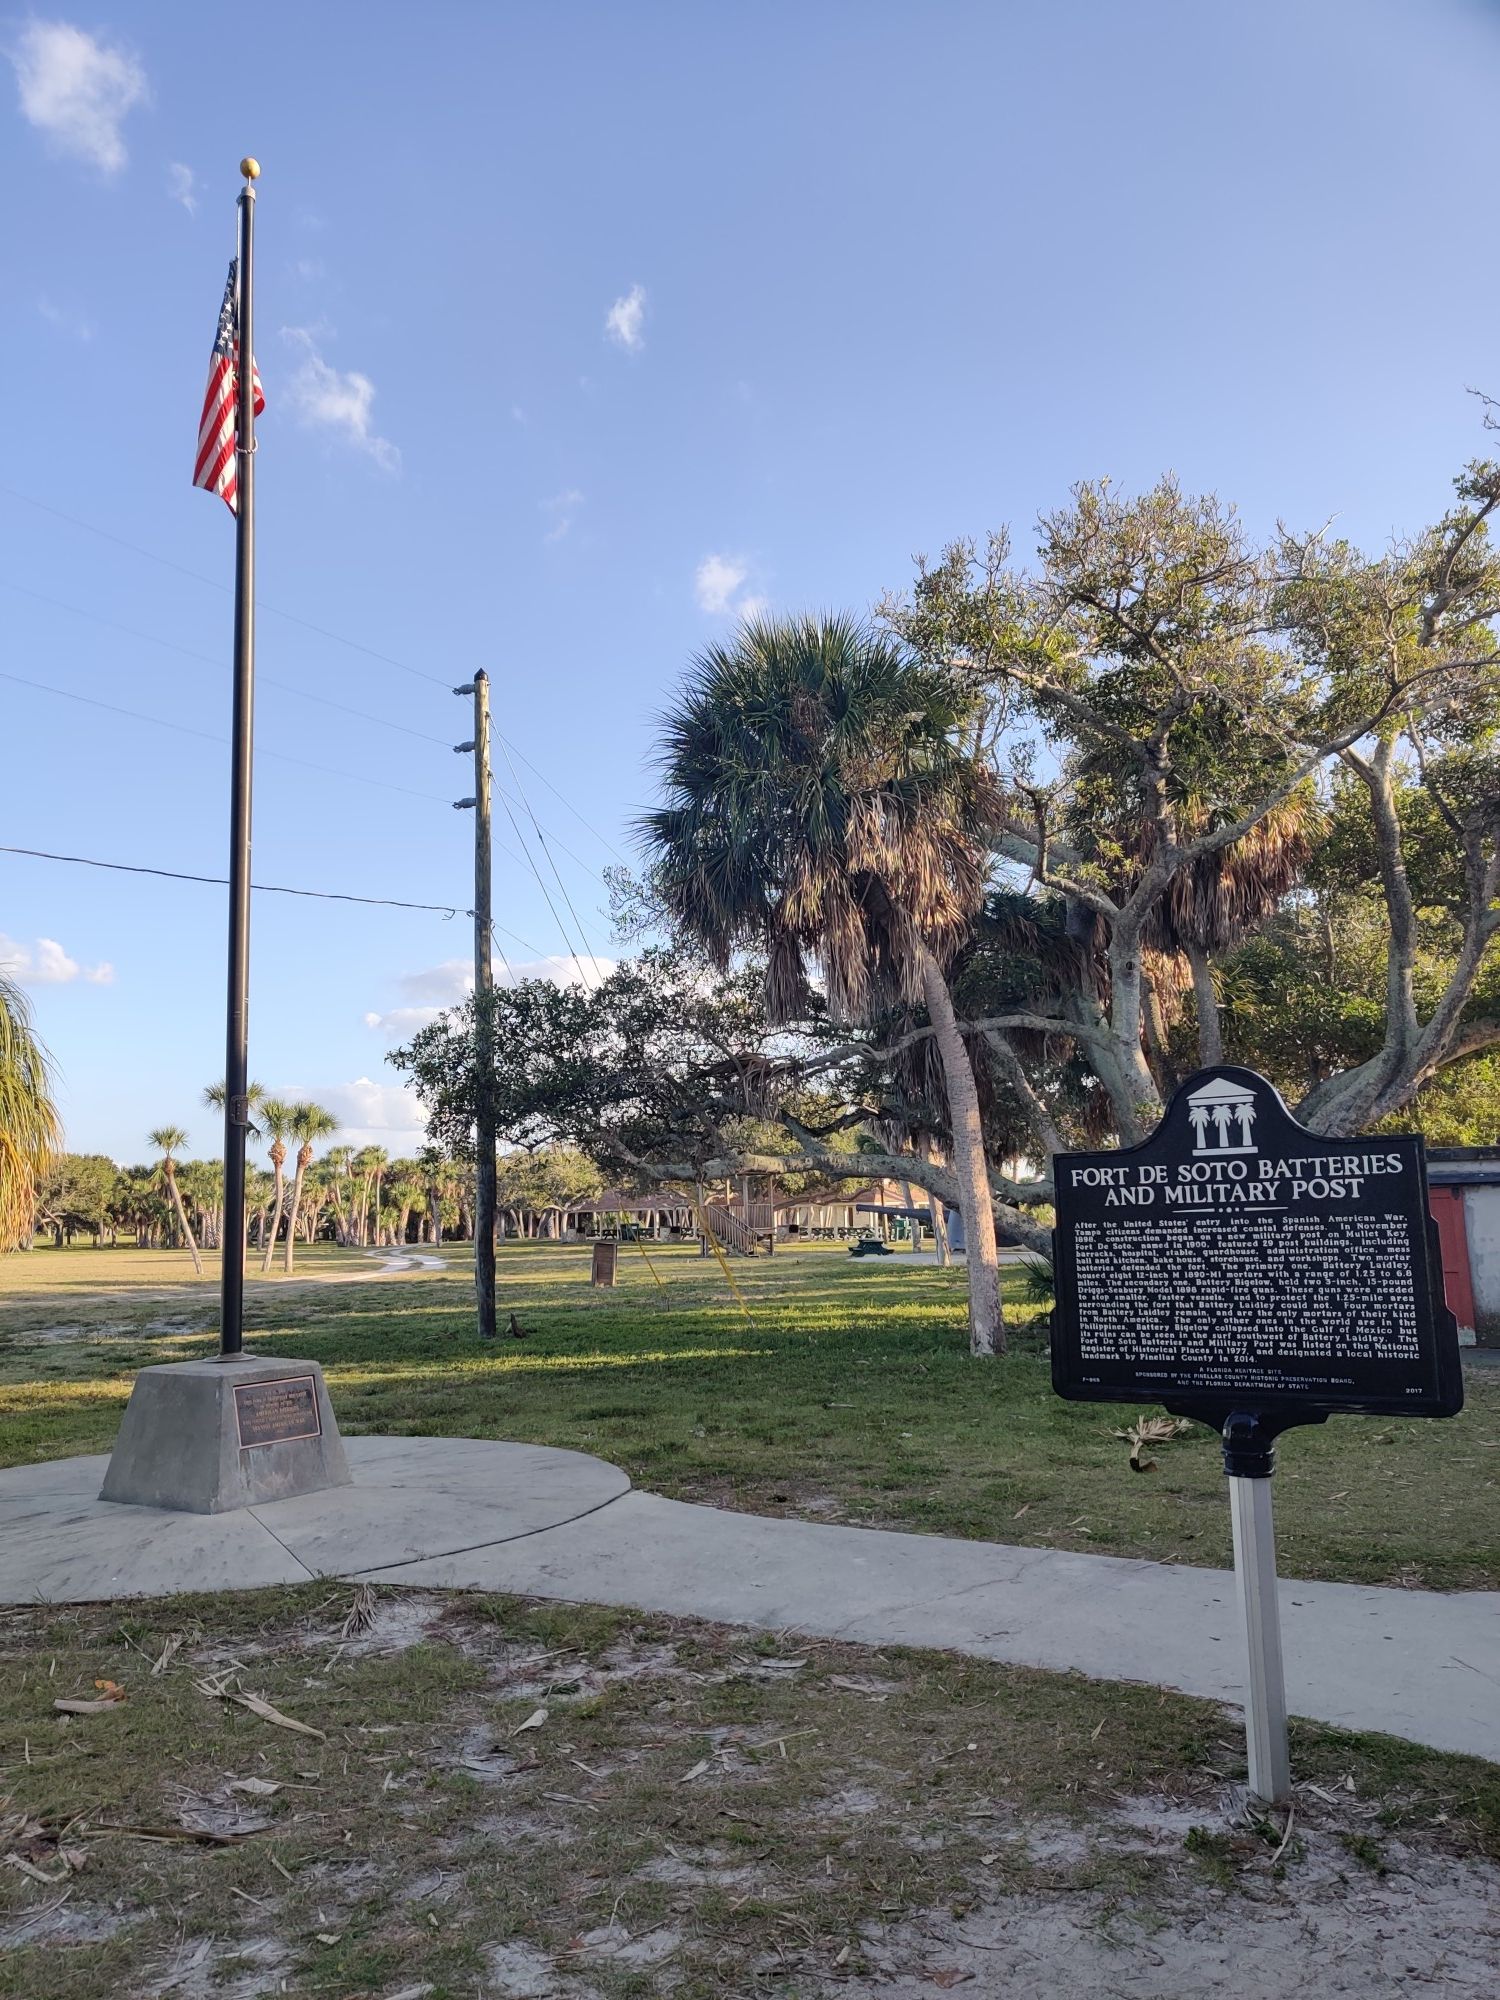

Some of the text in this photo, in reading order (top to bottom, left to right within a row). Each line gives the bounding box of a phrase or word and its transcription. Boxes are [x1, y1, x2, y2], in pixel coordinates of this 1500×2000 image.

[1071, 1153, 1404, 1187] FORT DE SOTO BATTERIES
[1104, 1178, 1365, 1207] AND MILITARY POST
[1195, 1218, 1220, 1226] entry
[1282, 1215, 1320, 1224] Spanish
[1328, 1214, 1375, 1222] American
[1074, 1229, 1100, 1237] Tampa
[1144, 1226, 1187, 1234] demanded
[1193, 1225, 1237, 1233] increased
[1356, 1221, 1407, 1229] November
[1166, 1234, 1193, 1242] began
[1252, 1232, 1291, 1240] military
[1299, 1231, 1320, 1239] post
[1278, 1239, 1298, 1247] post
[1361, 1237, 1409, 1246] including
[1266, 1246, 1338, 1254] administration
[1245, 1263, 1283, 1271] primary
[1323, 1262, 1361, 1270] Battery
[1124, 1279, 1169, 1287] secondary
[1196, 1278, 1230, 1286] Battery
[1367, 1278, 1412, 1286] 15-pound
[1201, 1286, 1248, 1294] rapid-fire
[1269, 1294, 1306, 1302] protect
[1078, 1301, 1129, 1309] surrounding
[1198, 1301, 1234, 1309] Battery
[1239, 1301, 1274, 1309] Laidley
[1102, 1308, 1134, 1316] Battery
[1138, 1308, 1170, 1316] Laidley
[1276, 1309, 1297, 1317] only
[1196, 1316, 1216, 1324] only
[1136, 1323, 1169, 1331] Battery
[1174, 1324, 1209, 1332] Bigelow
[1214, 1324, 1258, 1333] collapsed
[1302, 1333, 1340, 1342] Battery
[1208, 1339, 1247, 1348] Military
[1080, 1345, 1115, 1353] Register
[1132, 1345, 1176, 1353] Historical
[1277, 1348, 1331, 1358] designated
[1181, 1354, 1213, 1363] County
